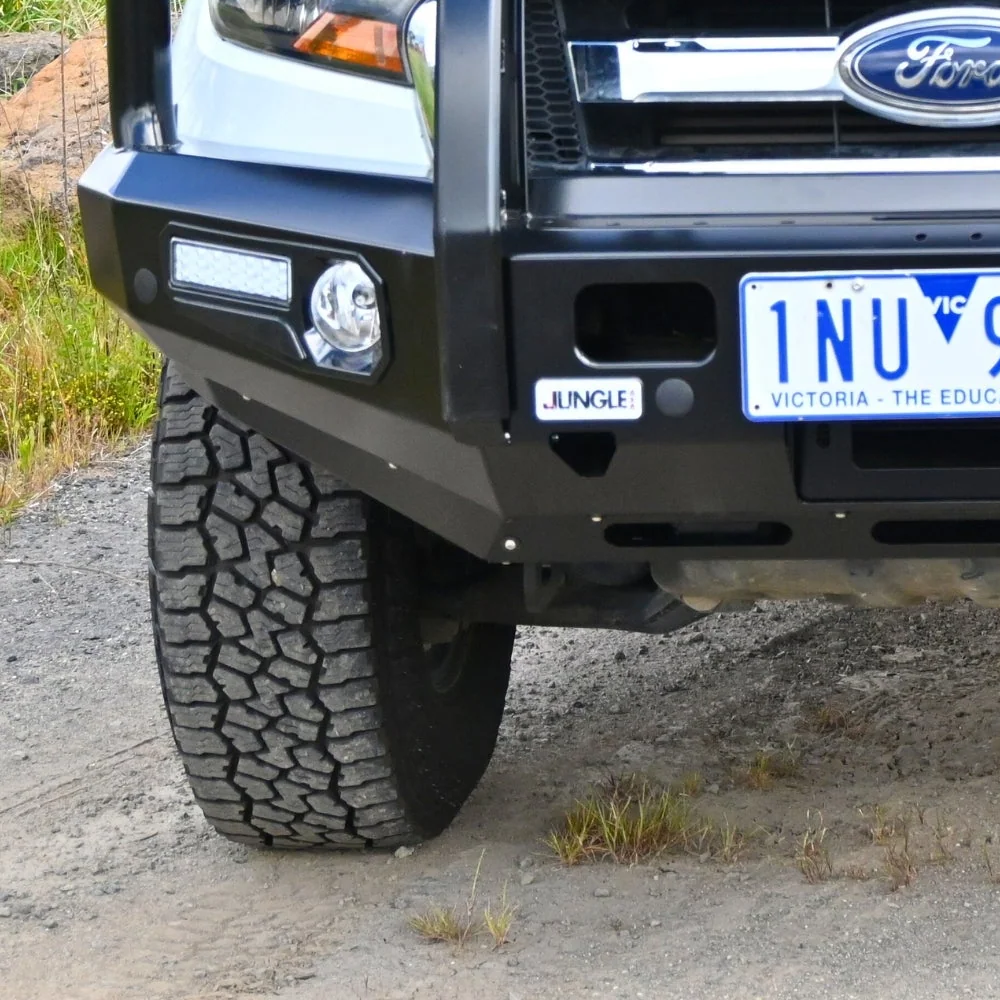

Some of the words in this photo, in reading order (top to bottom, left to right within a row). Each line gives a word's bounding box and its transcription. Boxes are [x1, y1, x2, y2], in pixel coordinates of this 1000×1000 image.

[924, 295, 967, 315] VIC
[770, 298, 909, 384] 1NU
[543, 389, 627, 409] JUNGLE
[771, 391, 869, 408] VICTORIA
[892, 389, 931, 406] THE
